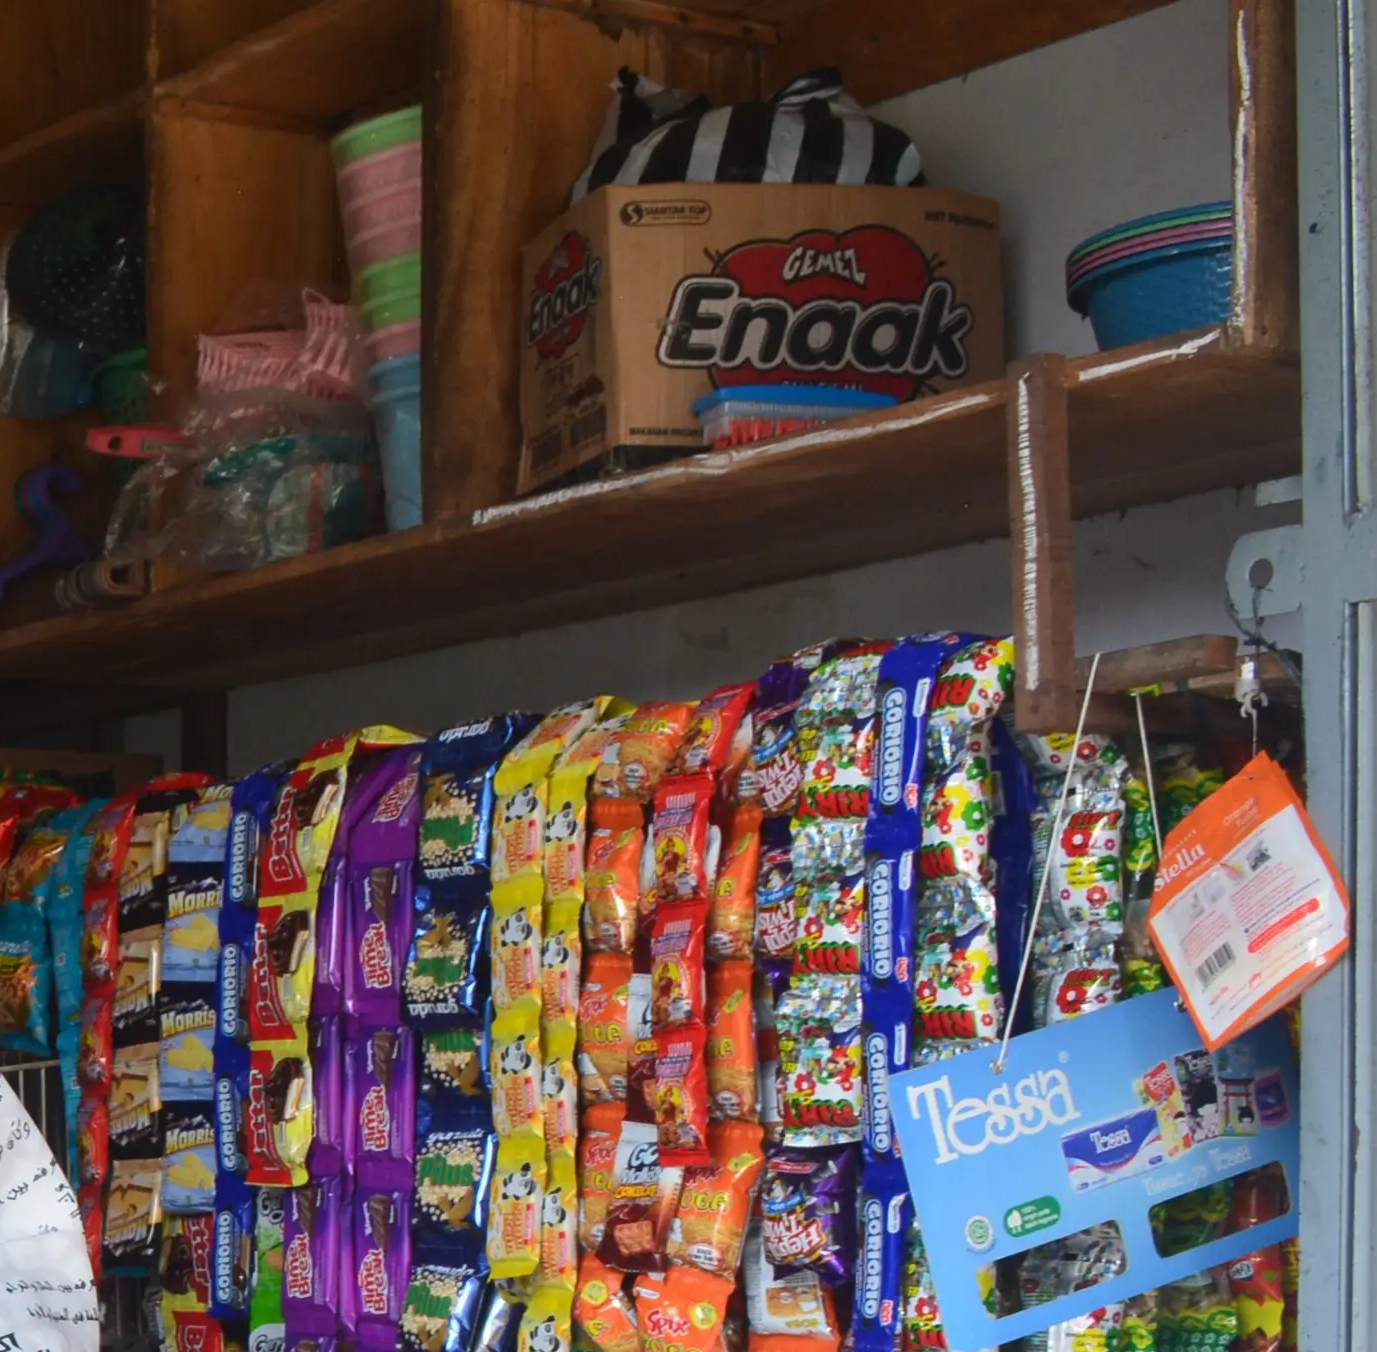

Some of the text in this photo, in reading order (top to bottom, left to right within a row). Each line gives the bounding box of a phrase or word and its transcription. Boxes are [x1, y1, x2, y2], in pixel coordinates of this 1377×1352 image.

[526, 247, 602, 347] Enaak
[782, 244, 867, 286] GEMEZ
[657, 275, 973, 376] Enaak
[880, 687, 907, 805] GORIORIO
[268, 785, 296, 883] Better
[1153, 842, 1206, 893] Stella
[870, 860, 893, 978] GORIORIO
[360, 935, 376, 988] Time
[375, 920, 392, 989] Break
[407, 1000, 459, 1018] garuda
[921, 1007, 979, 1038] RIR
[360, 1094, 375, 1150] Time
[373, 1084, 390, 1151] Break
[866, 1033, 892, 1153] GORIORIO
[906, 1067, 1081, 1166] Tessa
[417, 1152, 474, 1187] Pilus
[1089, 1126, 1132, 1155] Tessa
[358, 1258, 373, 1314] Time
[371, 1247, 387, 1315] Break
[862, 1199, 883, 1319] GORIORIO
[647, 1310, 691, 1337] Spix
